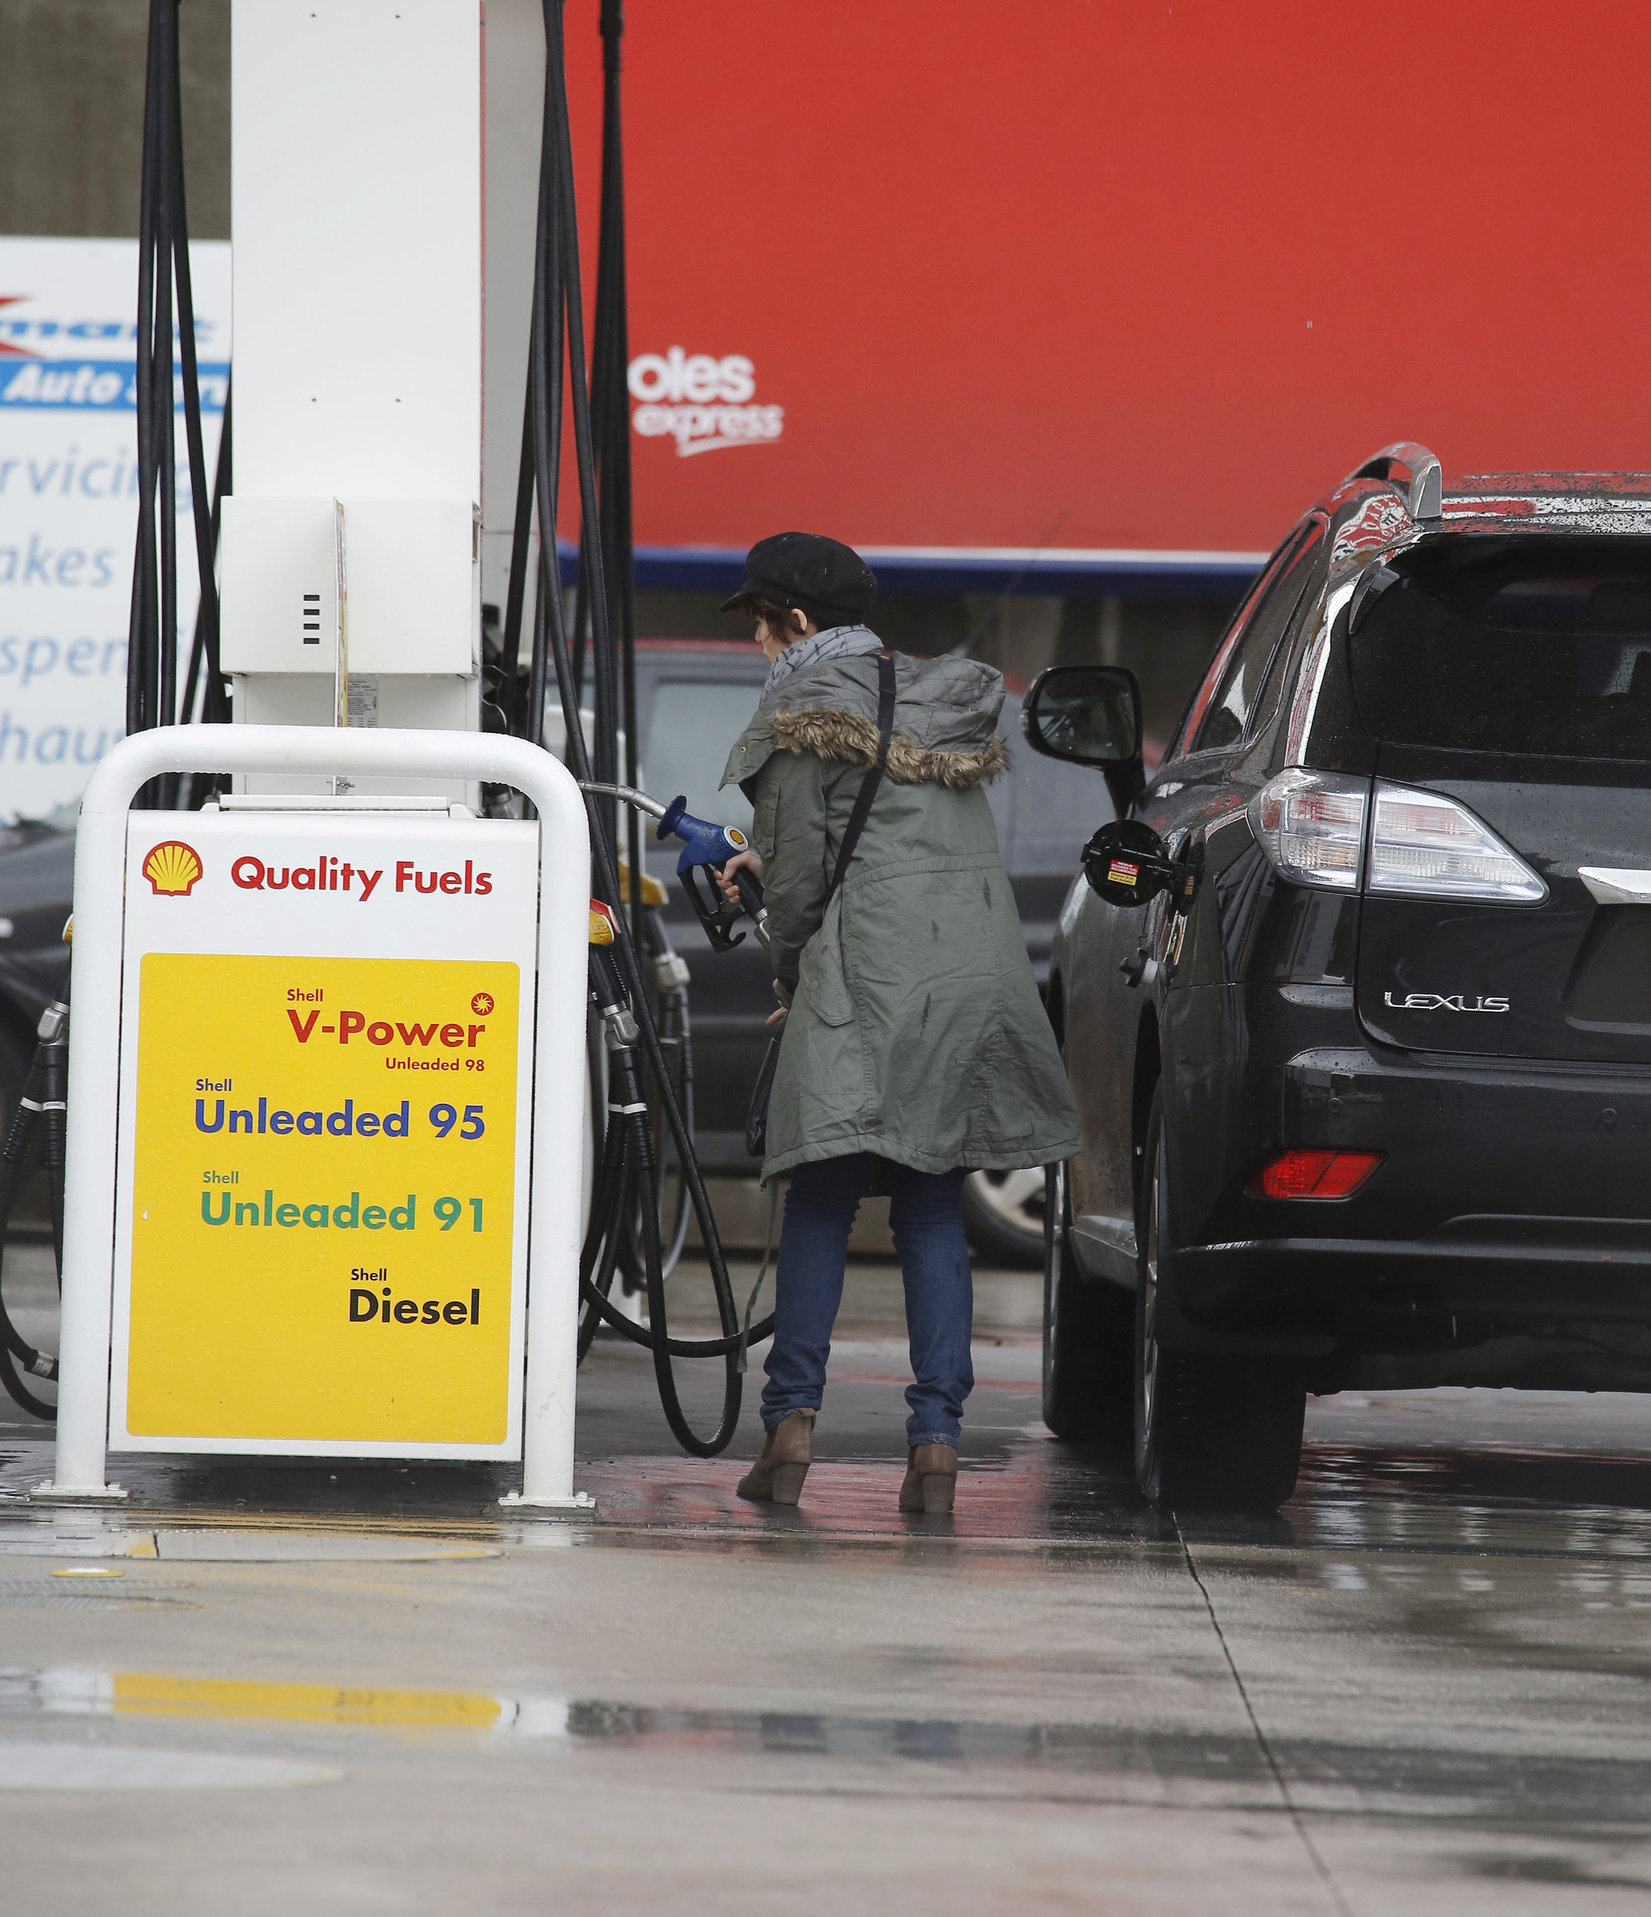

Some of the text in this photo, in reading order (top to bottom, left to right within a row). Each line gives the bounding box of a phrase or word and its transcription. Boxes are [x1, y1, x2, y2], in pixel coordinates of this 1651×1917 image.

[3, 362, 123, 404] Auto
[628, 346, 756, 403] oles
[632, 404, 785, 456] express
[0, 443, 193, 513] rvicig
[230, 855, 493, 902] Quality Fuels
[286, 988, 324, 1002] Shell
[1384, 991, 1510, 1013] LEXUS
[286, 1009, 486, 1048] V-Power
[385, 1056, 485, 1072] Unleaded 98
[195, 1077, 232, 1092] Shell
[195, 1096, 486, 1140] Unleaded 95
[203, 1170, 239, 1184] Shell
[201, 1189, 484, 1233] Unleaded 91
[351, 1267, 387, 1282] Shell
[349, 1287, 481, 1326] Diesel
